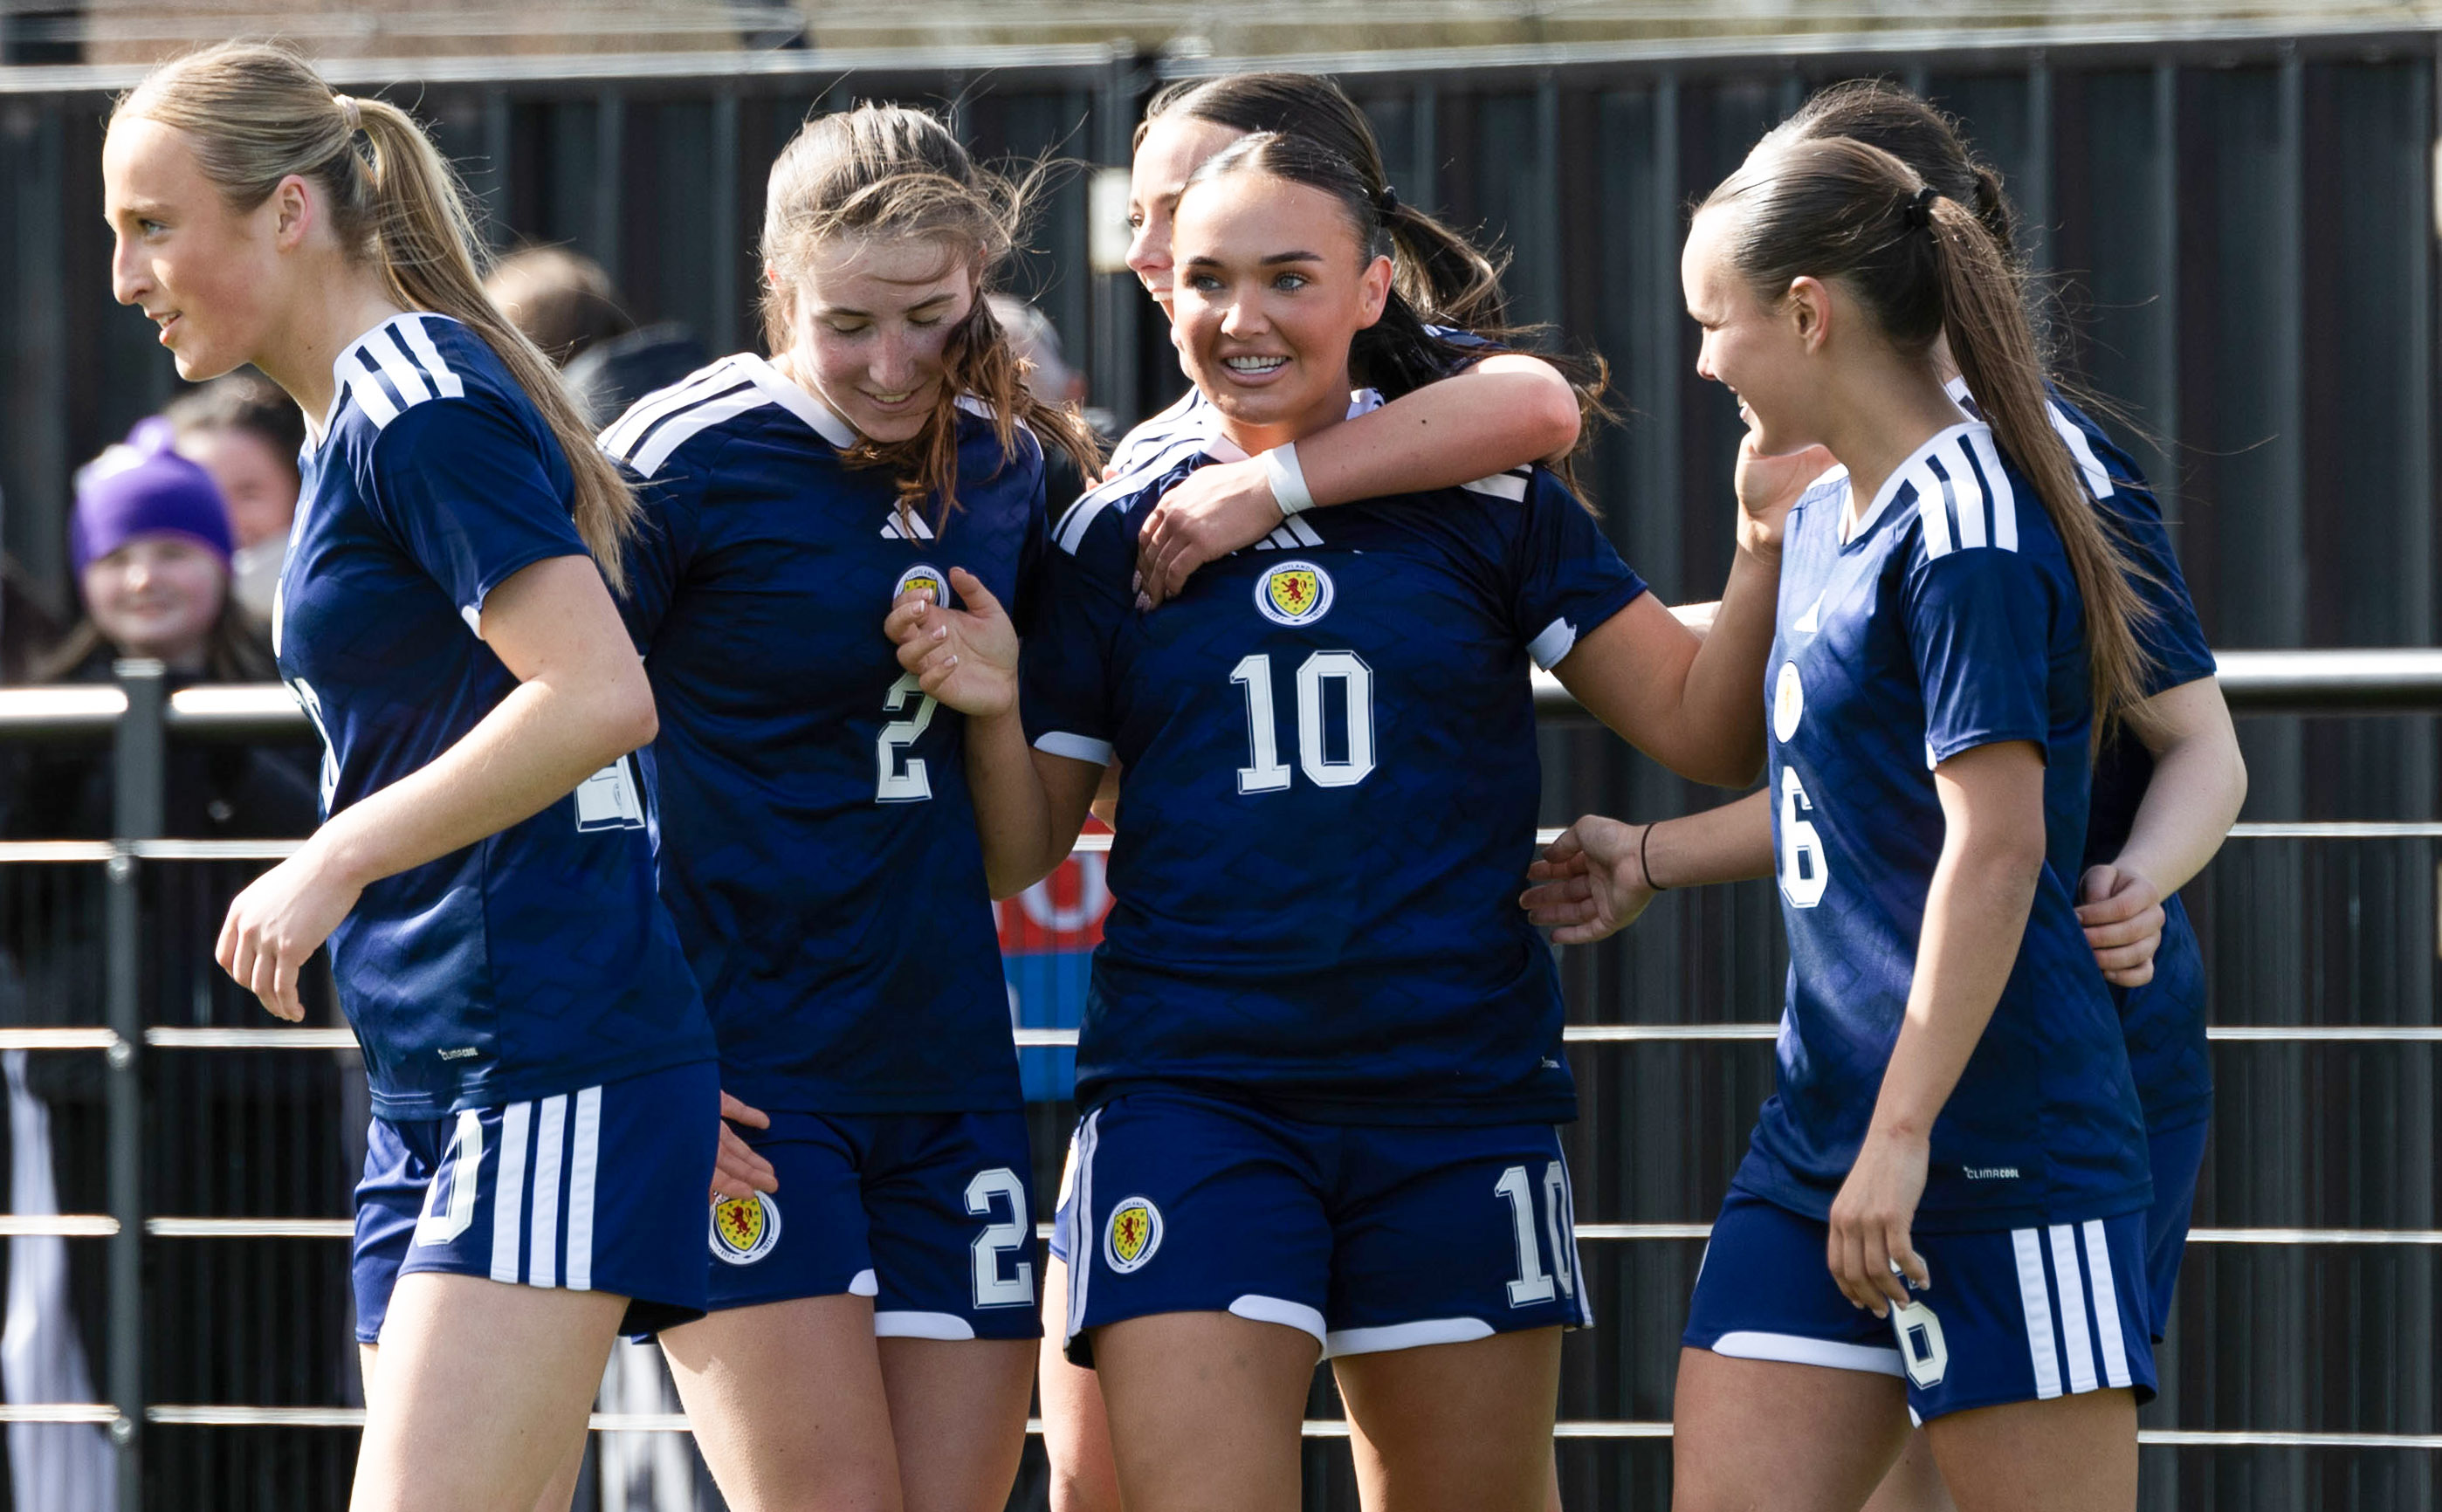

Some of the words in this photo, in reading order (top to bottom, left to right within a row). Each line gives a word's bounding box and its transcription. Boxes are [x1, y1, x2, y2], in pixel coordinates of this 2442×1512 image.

[875, 672, 938, 803] 2
[1229, 649, 1376, 794] 10
[1779, 766, 1828, 908] 6
[964, 1167, 1035, 1309] 2
[1495, 1160, 1573, 1309] 10
[1966, 1168, 2020, 1179] CLIMACOOL
